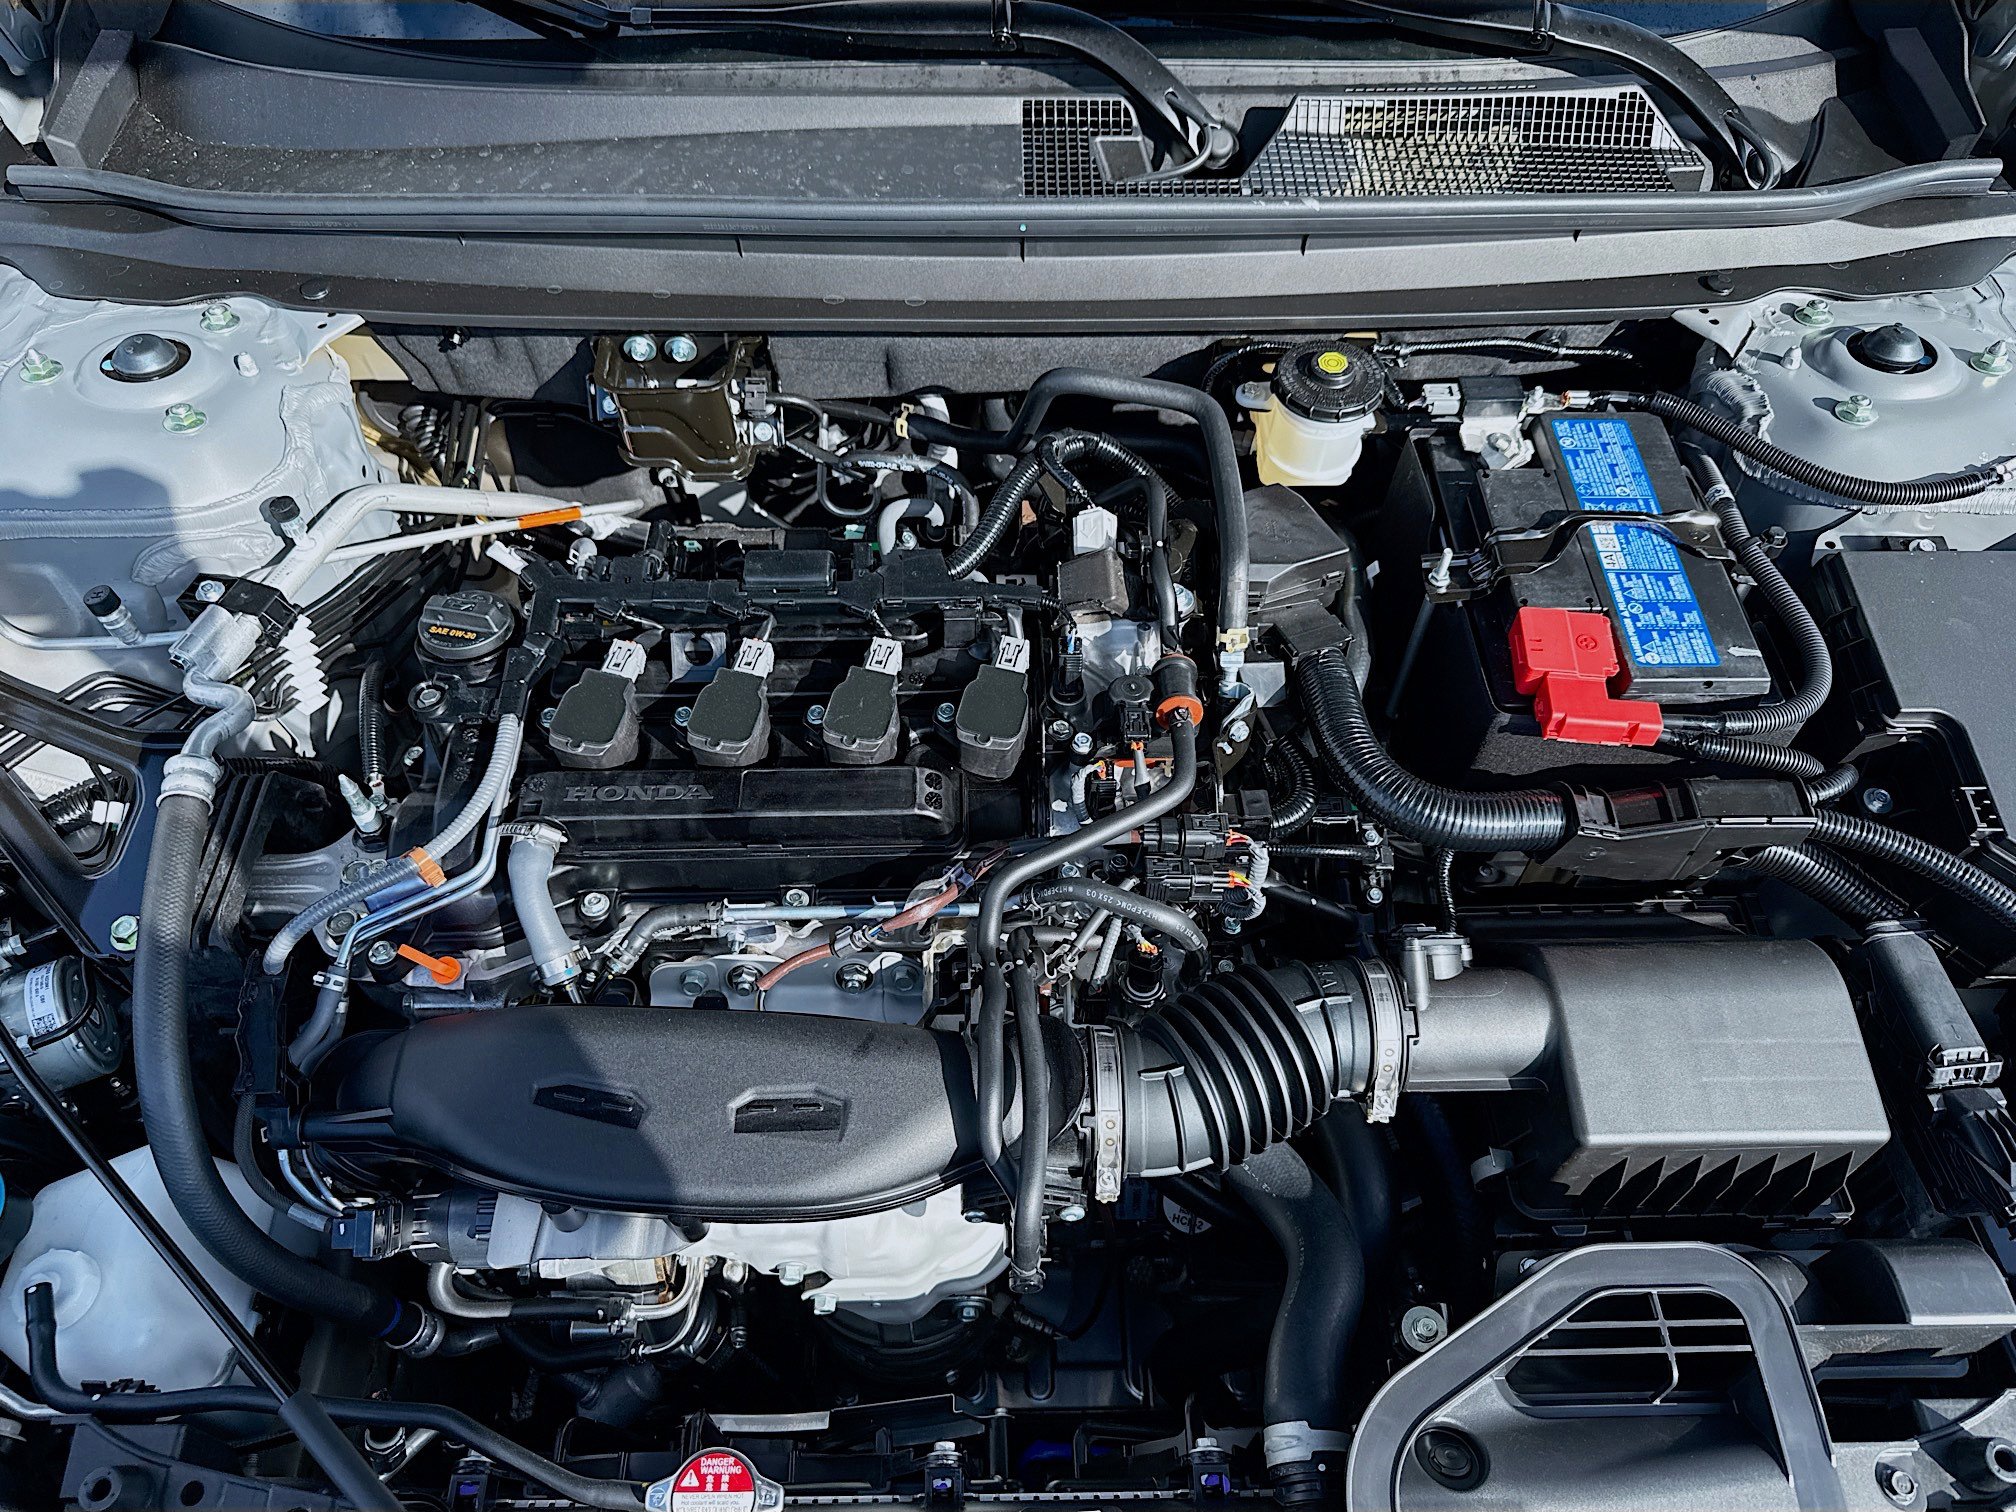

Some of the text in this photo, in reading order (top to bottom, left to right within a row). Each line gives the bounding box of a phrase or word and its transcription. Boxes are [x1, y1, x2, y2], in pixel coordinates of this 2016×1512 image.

[429, 626, 477, 640] SAE 0W-20
[563, 784, 714, 801] HONDA
[1086, 888, 1097, 898] 03
[1098, 893, 1114, 904] 25X
[701, 1457, 735, 1466] DANGER
[701, 1465, 742, 1475] WARNUNG
